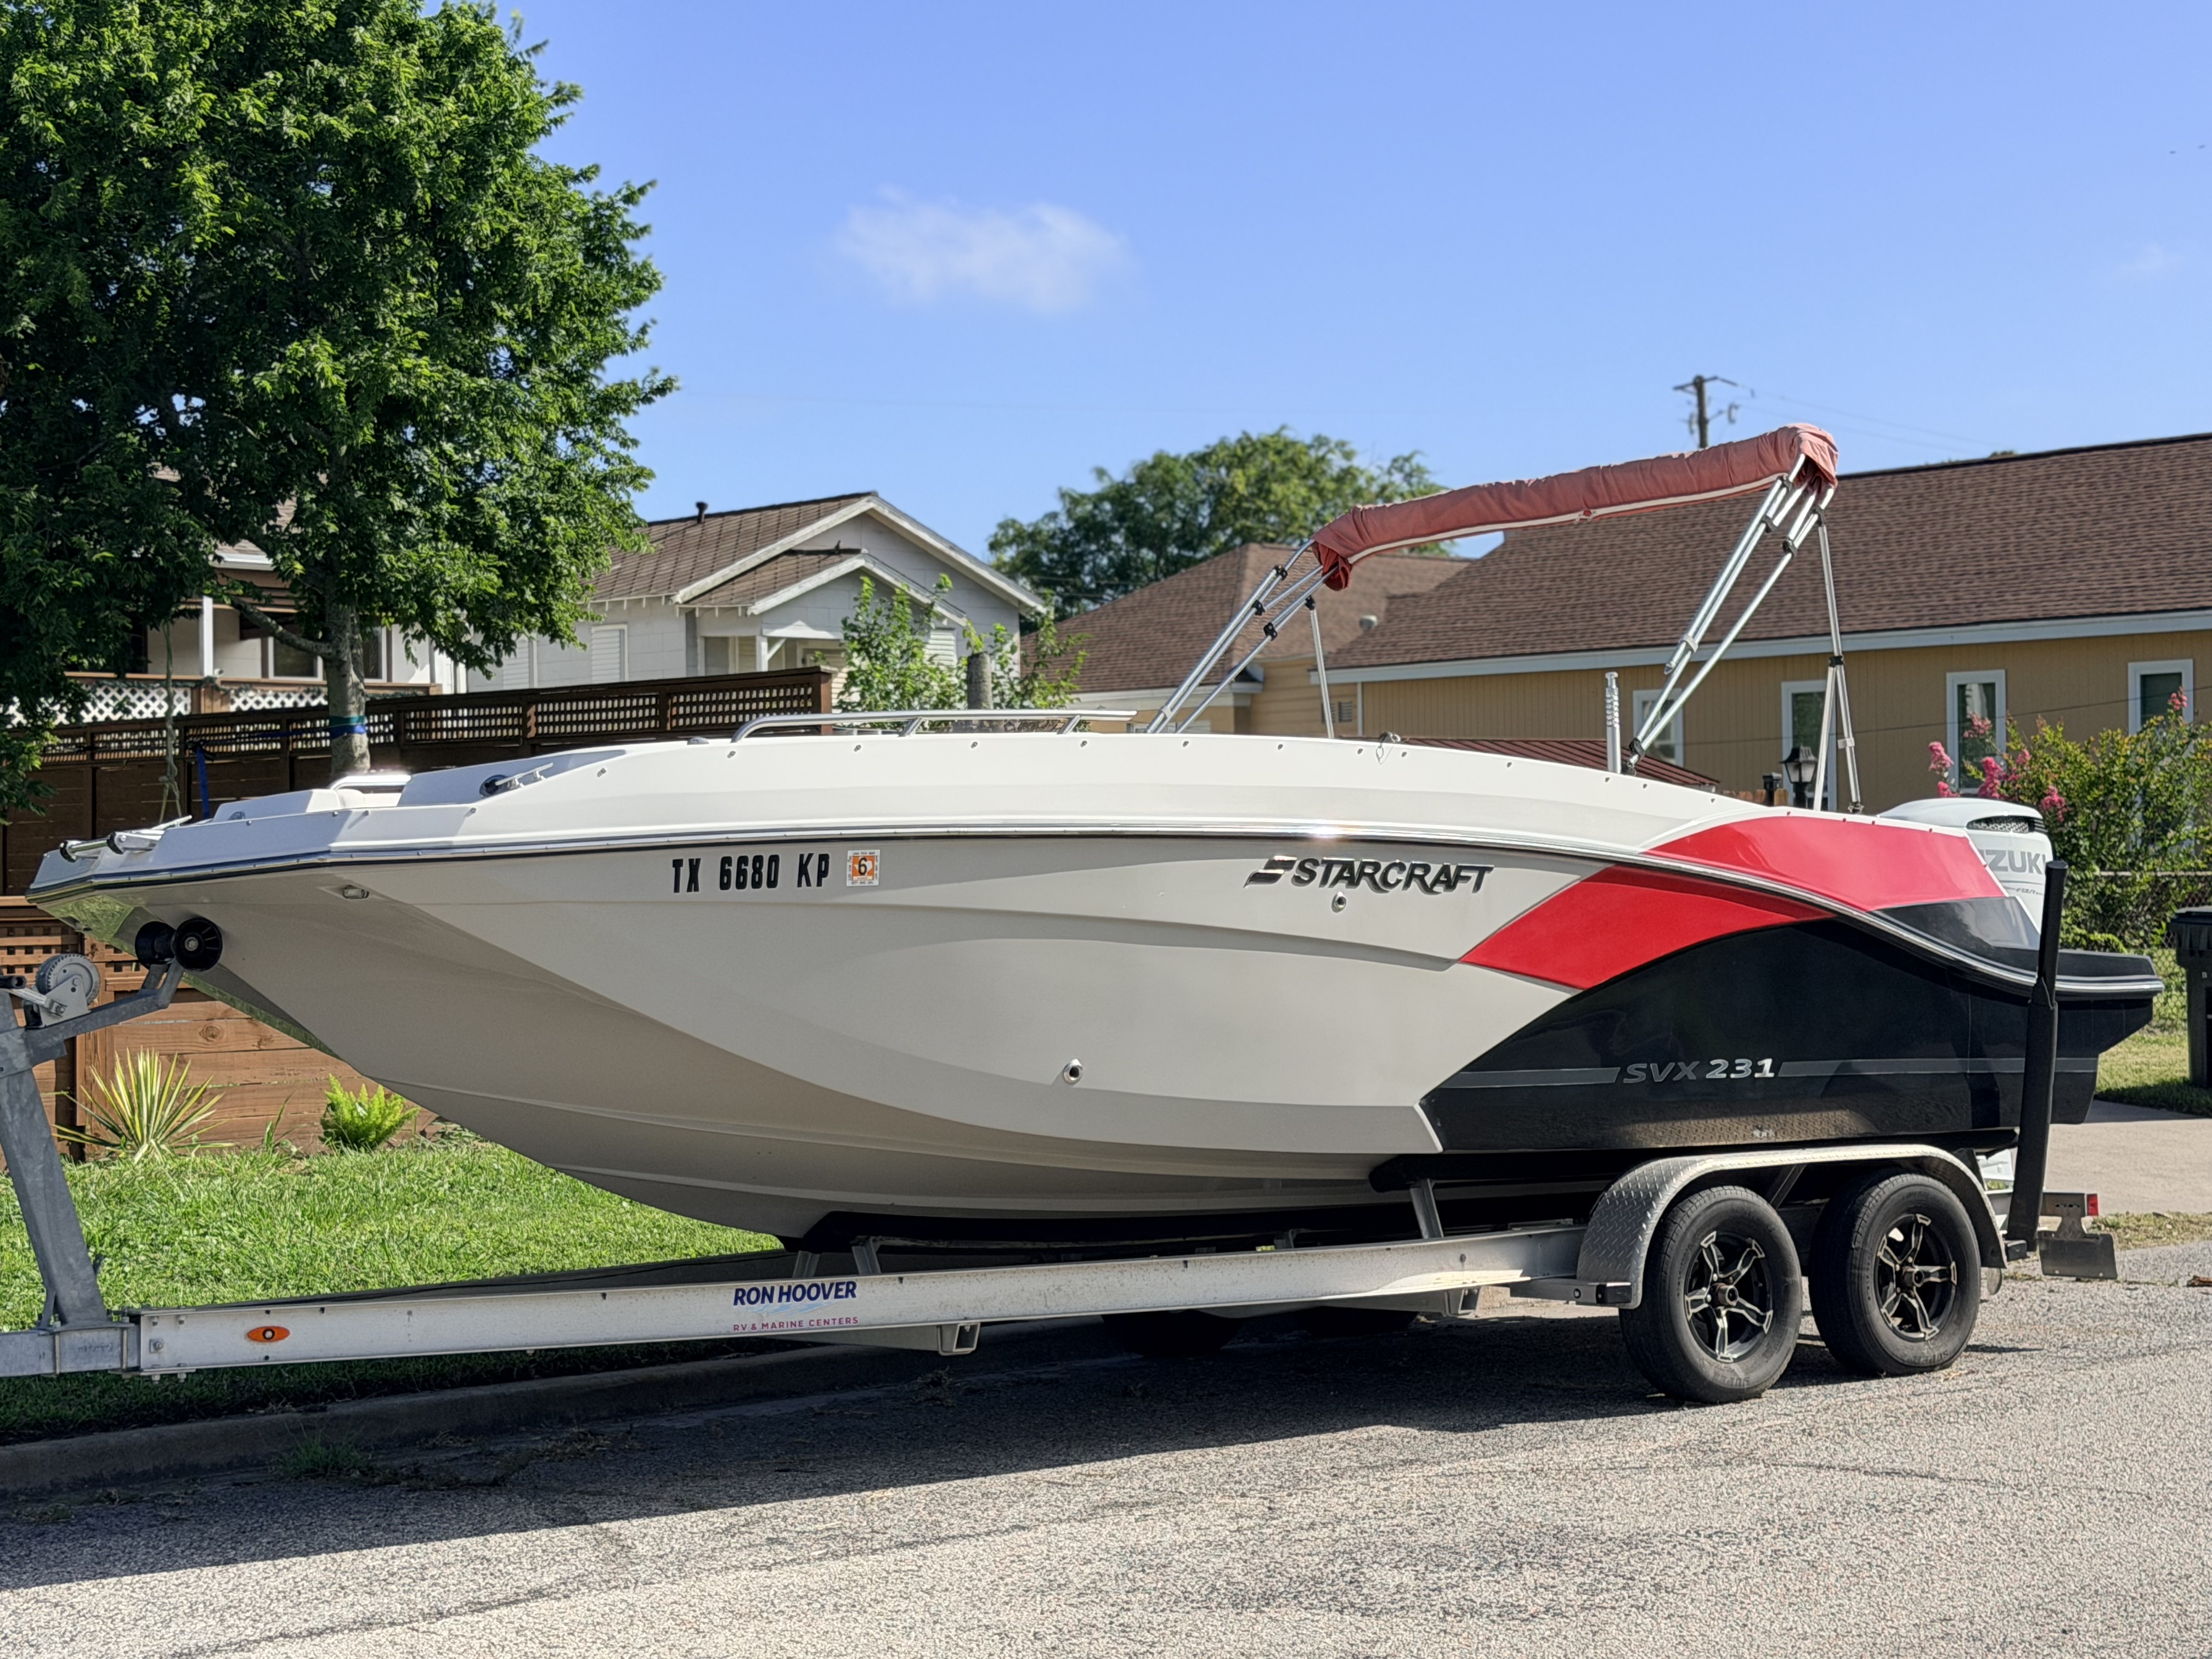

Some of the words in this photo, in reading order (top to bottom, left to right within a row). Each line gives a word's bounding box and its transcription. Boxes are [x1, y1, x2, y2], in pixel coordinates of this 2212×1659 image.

[672, 858, 701, 893] TX
[719, 854, 780, 891] 6680
[797, 853, 830, 888] KP
[858, 857, 867, 876] 6
[1291, 857, 1494, 895] STARCRAFT
[1623, 1061, 1700, 1084] SVX
[1706, 1058, 1775, 1079] 231
[733, 1285, 775, 1306] RON
[777, 1281, 857, 1303] HOOVER
[733, 1323, 747, 1331] RV
[761, 1319, 804, 1330] MARINE
[809, 1317, 859, 1327] CENTERS
